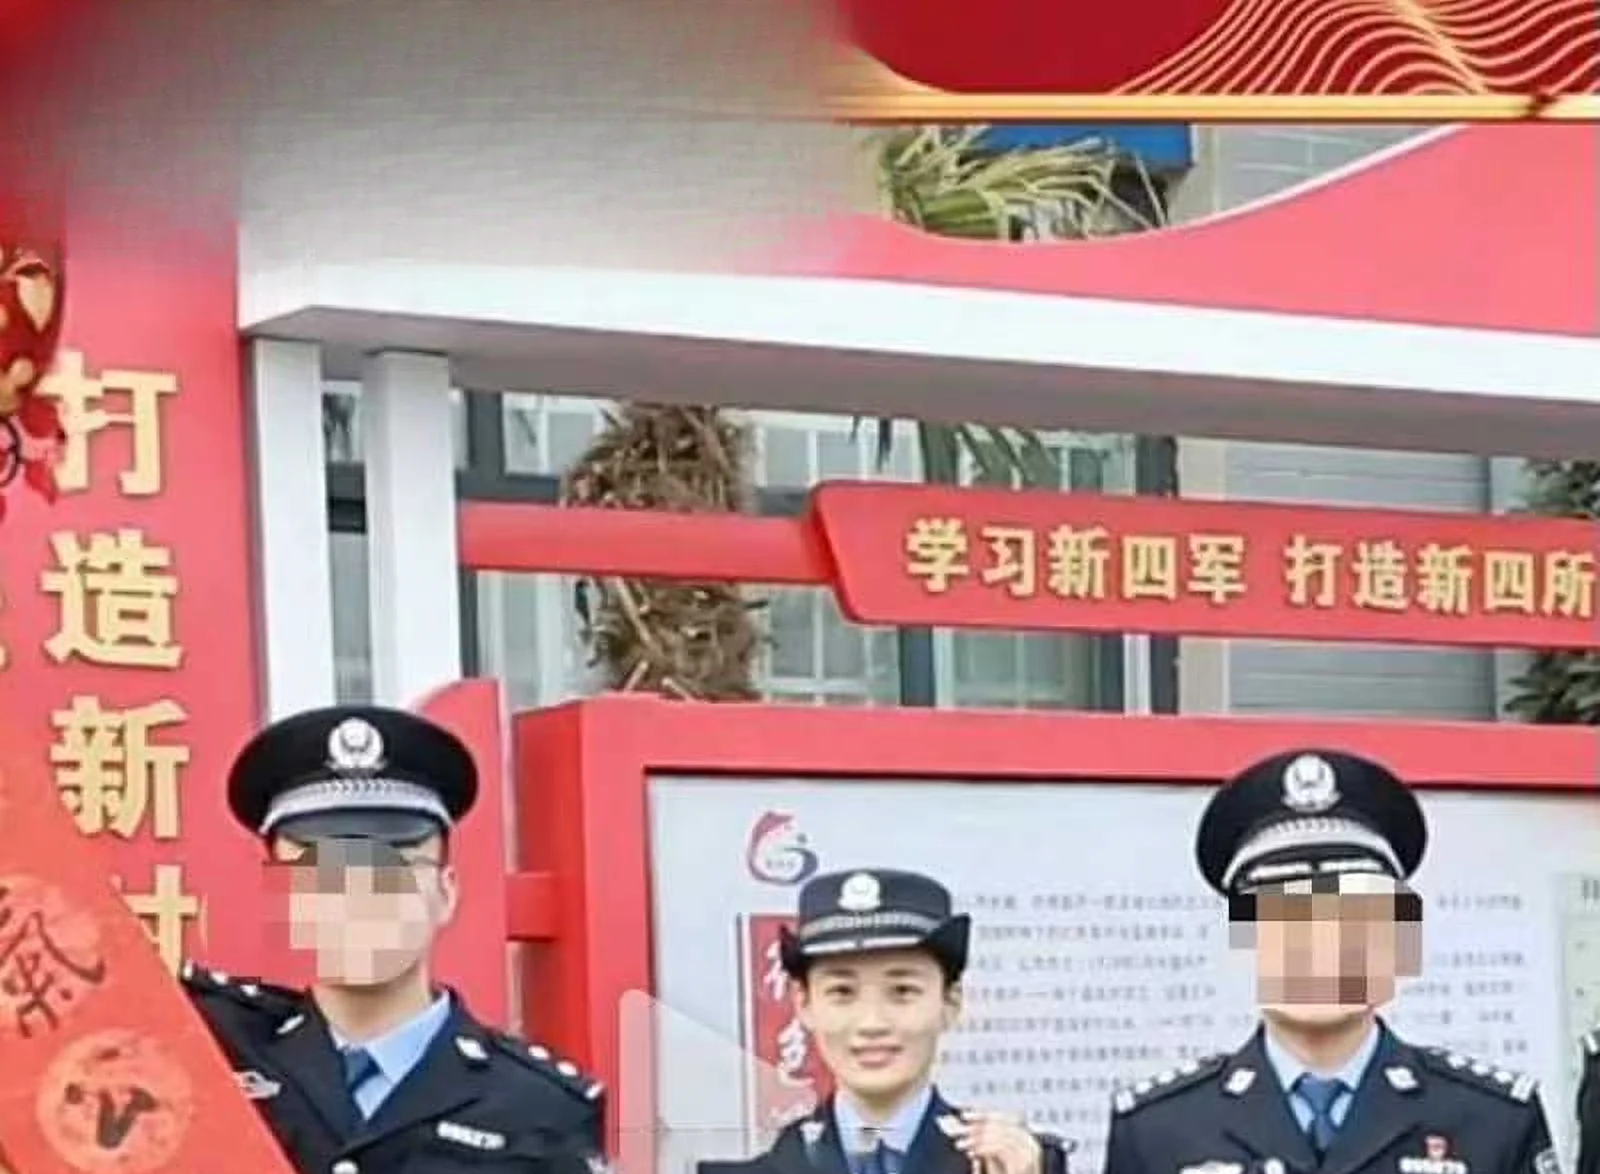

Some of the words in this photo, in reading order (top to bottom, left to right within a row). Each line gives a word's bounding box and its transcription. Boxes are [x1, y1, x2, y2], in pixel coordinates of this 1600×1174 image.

[904, 517, 1247, 603] 学习新四军
[1284, 535, 1597, 618] 打造新四所
